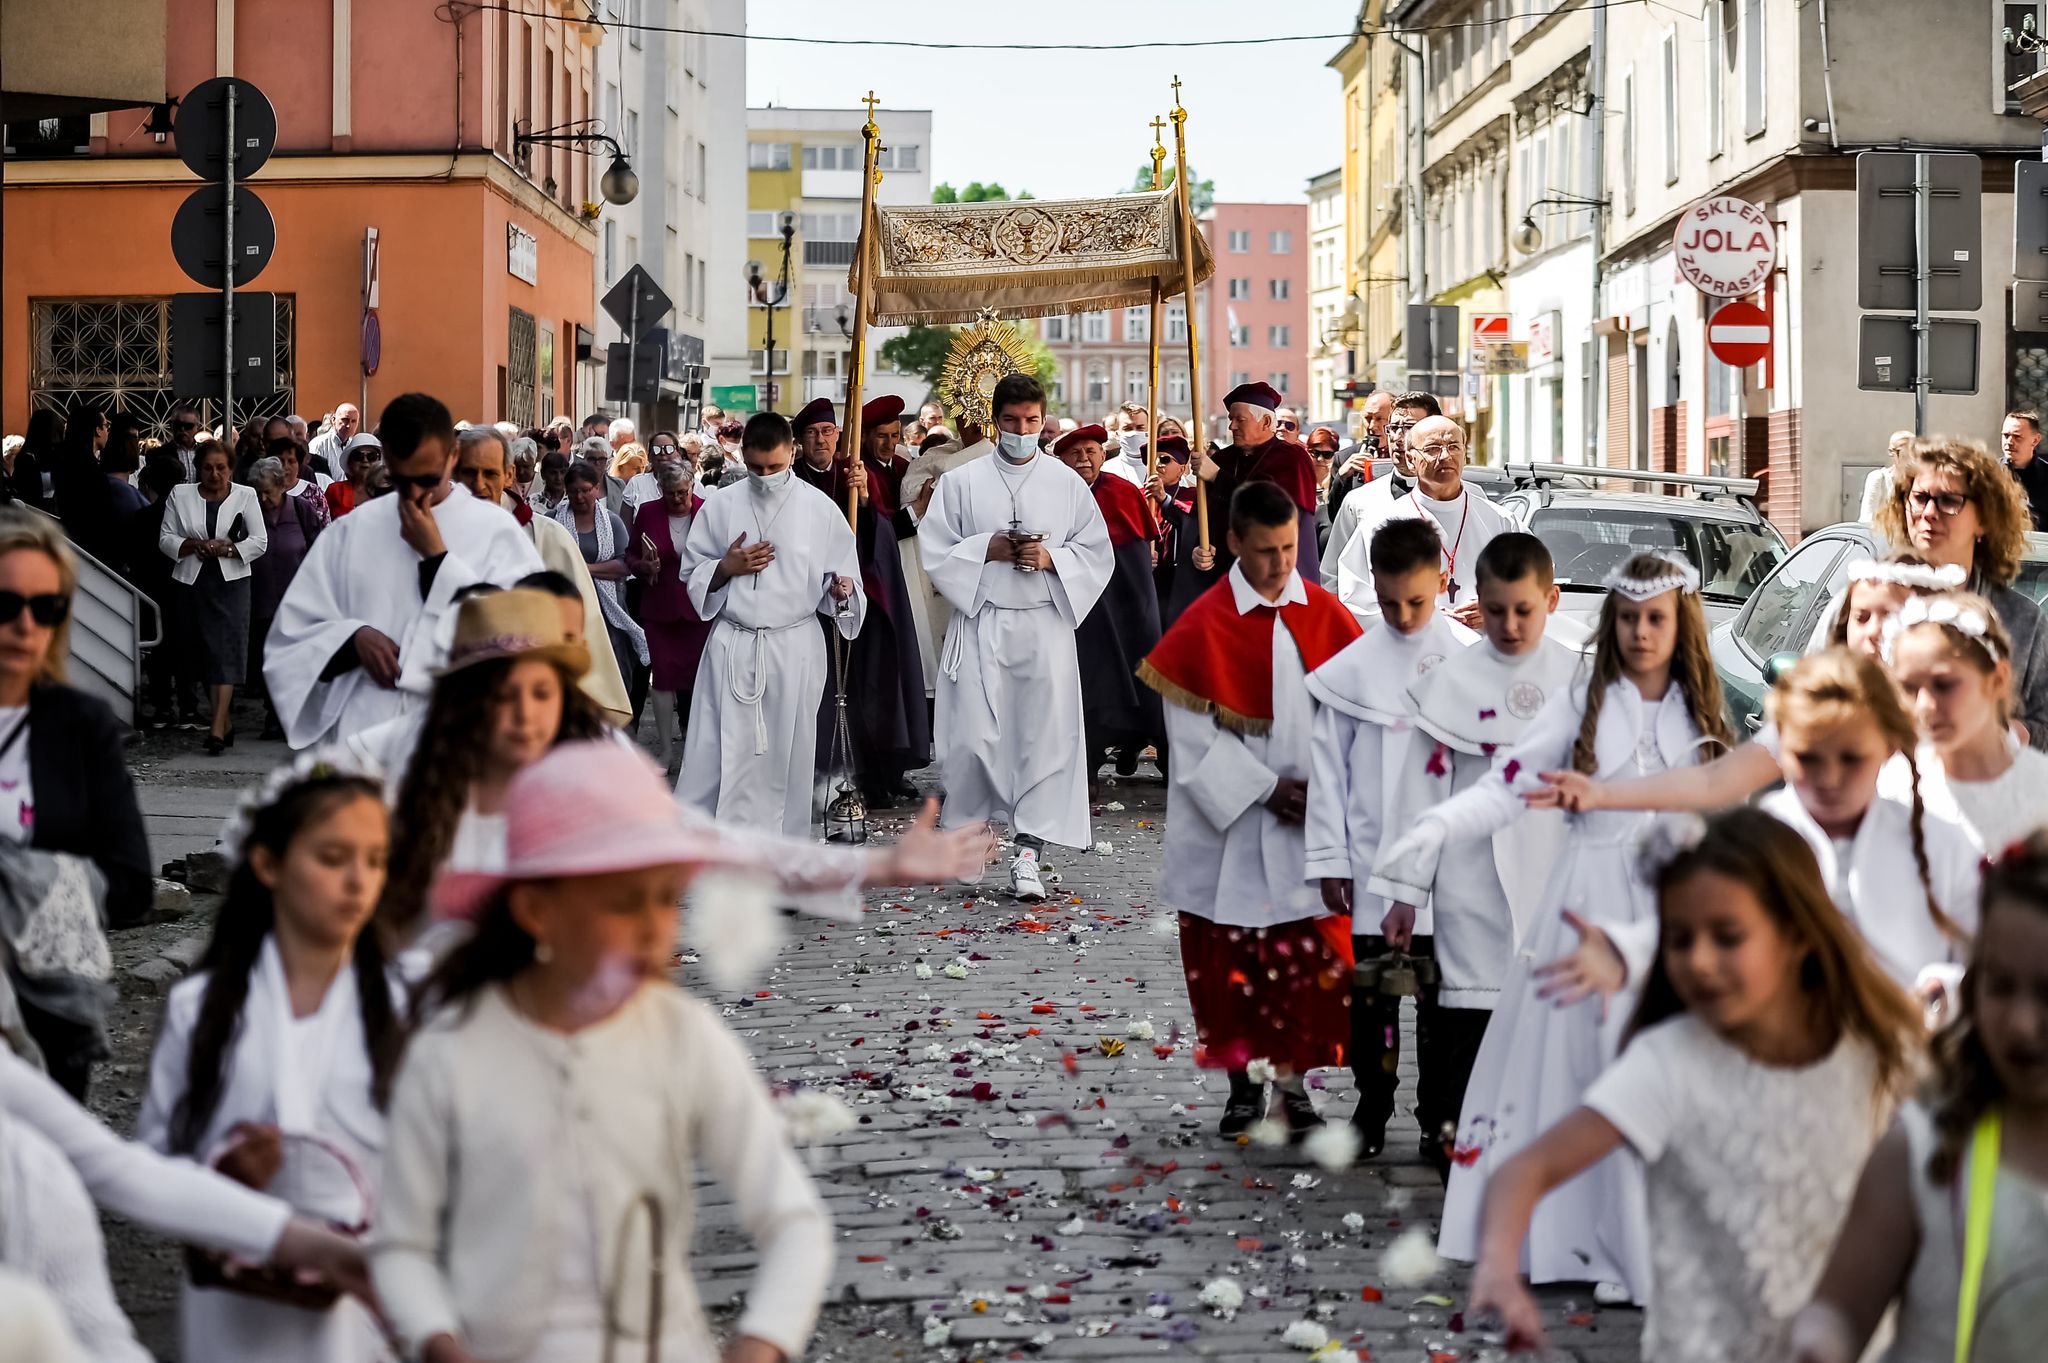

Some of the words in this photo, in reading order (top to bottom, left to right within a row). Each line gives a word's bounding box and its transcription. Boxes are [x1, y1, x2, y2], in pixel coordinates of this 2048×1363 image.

[1696, 200, 1764, 226] SKLEP
[1683, 229, 1770, 253] JOLA
[1682, 255, 1769, 293] ZAPRASZA
